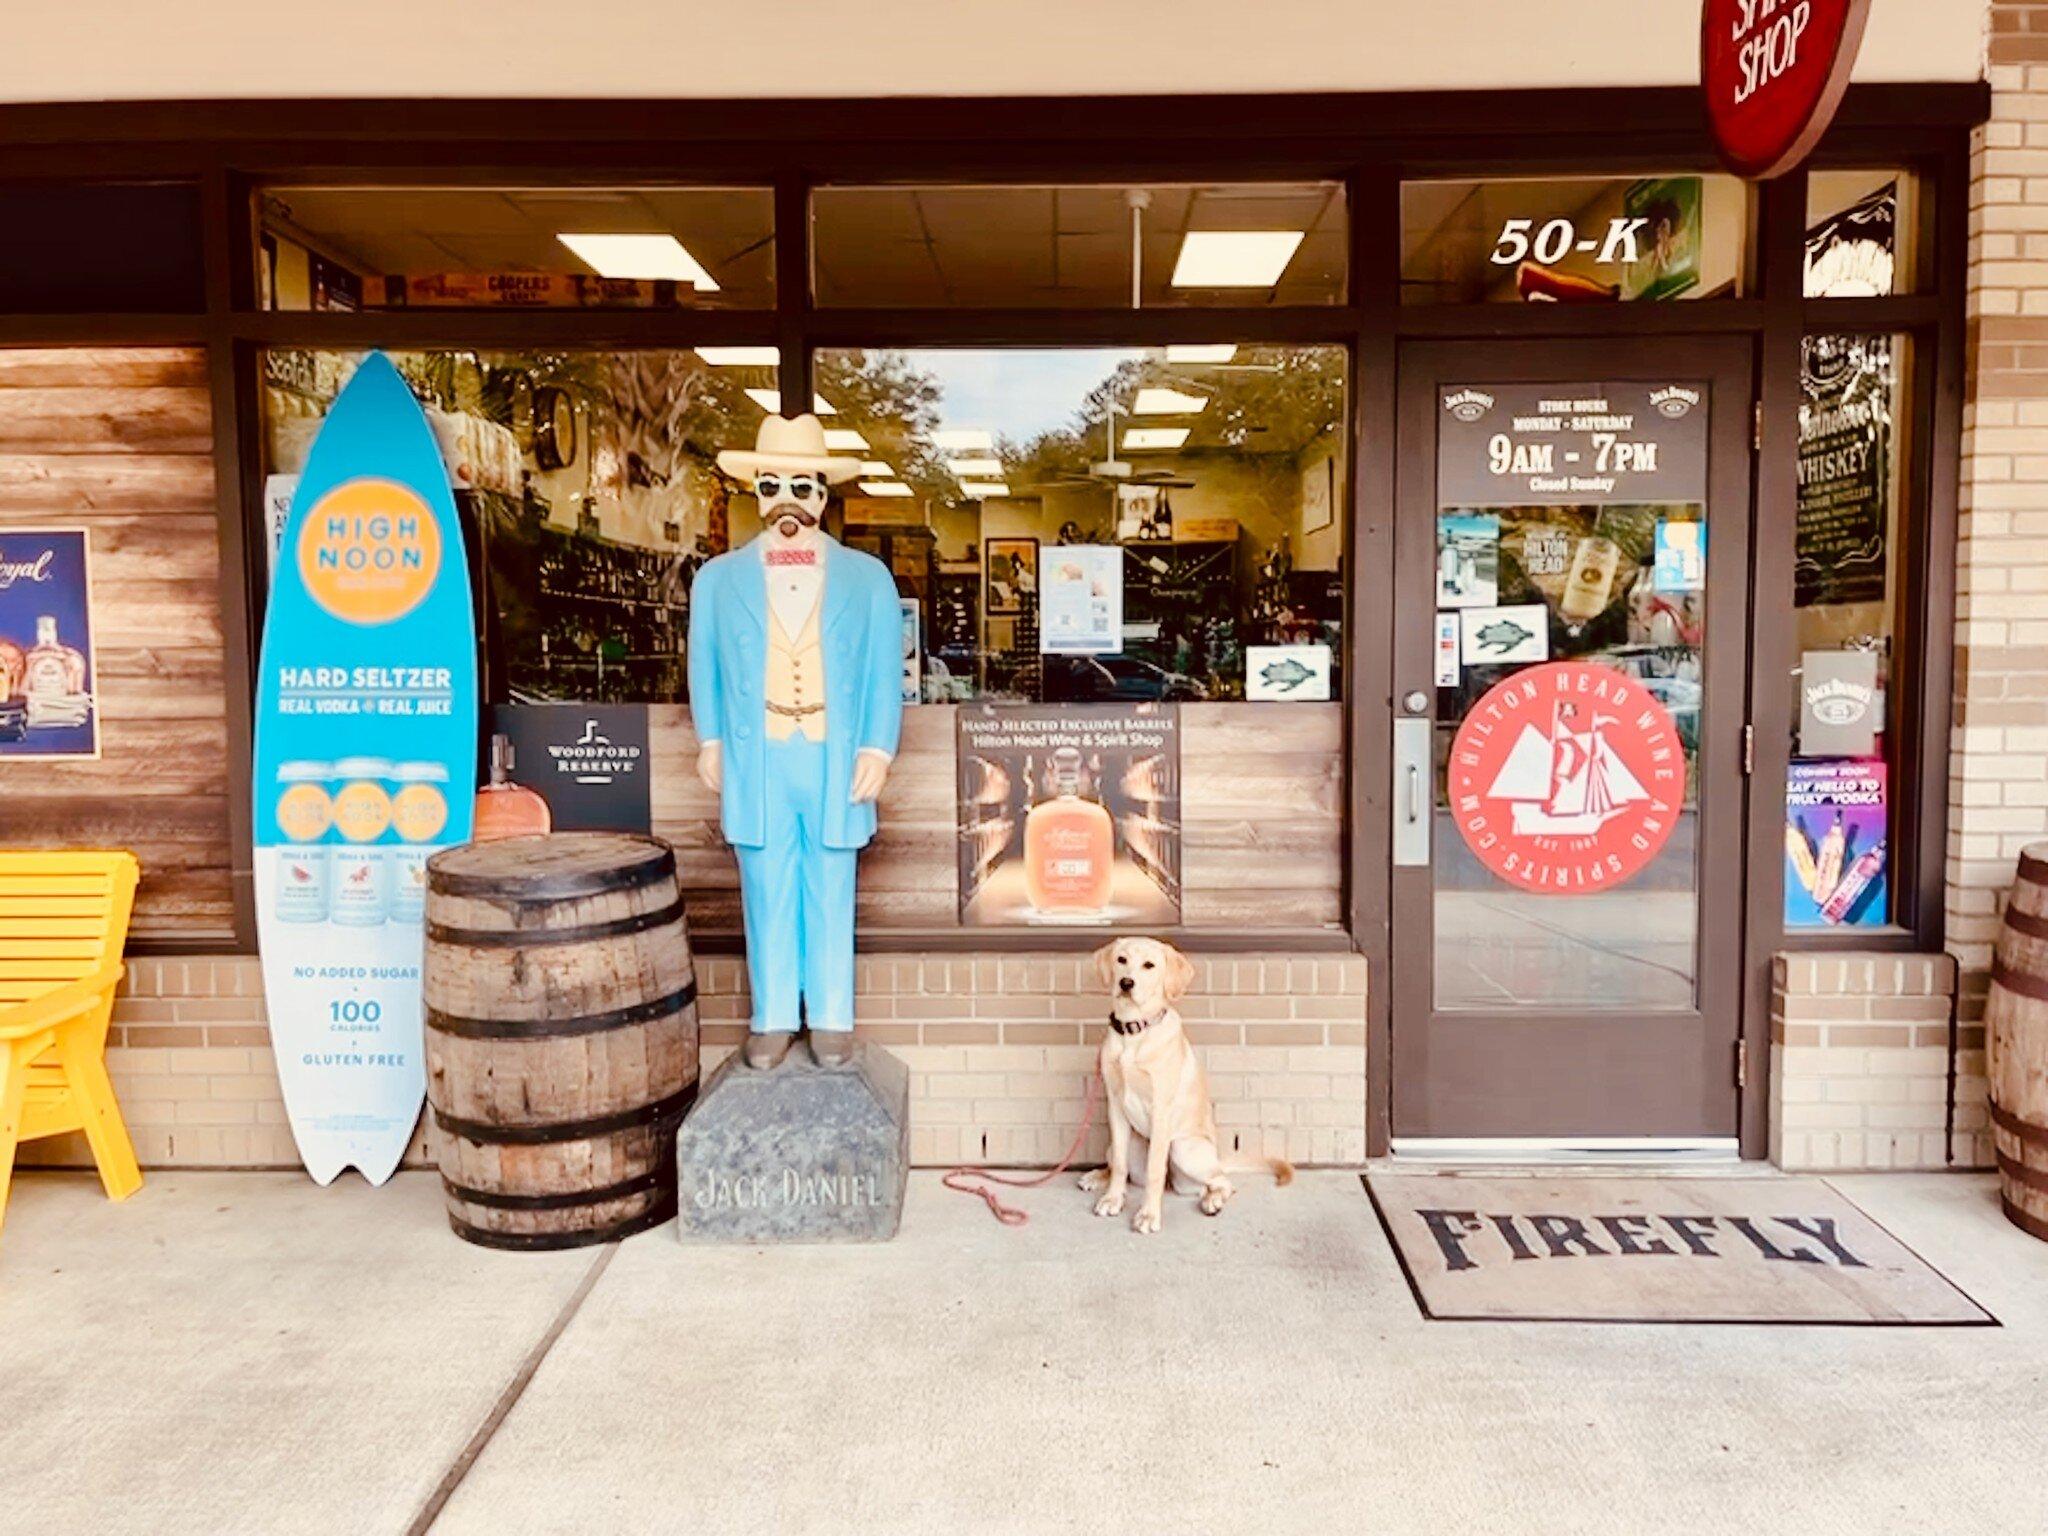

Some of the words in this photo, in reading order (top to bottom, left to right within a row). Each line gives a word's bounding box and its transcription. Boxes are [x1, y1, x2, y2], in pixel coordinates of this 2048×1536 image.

[1734, 1, 1810, 104] SHOP
[1490, 217, 1649, 265] 50-K
[1512, 416, 1562, 431] MONDAY
[1571, 415, 1634, 431] SATURDAY
[1488, 433, 1554, 475] 9AM
[1591, 432, 1657, 472] 7PM
[1529, 477, 1569, 493] Closed
[1570, 476, 1615, 493] Sunday
[328, 517, 416, 540] HIGH
[319, 546, 421, 571] NOON
[280, 667, 348, 688] HARD
[353, 667, 452, 688] SELTZER
[1556, 672, 1629, 706] HEAD
[279, 699, 313, 715] REAL
[315, 699, 360, 715] VODKA
[377, 699, 414, 715] REAL
[1002, 719, 1059, 731] SELECTED
[1459, 679, 1538, 767] HILTON
[548, 745, 641, 758] WOODFORD
[973, 734, 1012, 748] Hilton
[1013, 734, 1047, 747] Head
[1050, 734, 1081, 746] Wine
[1082, 734, 1094, 746] &
[1094, 734, 1129, 748] Spirit
[1130, 734, 1165, 748] Shop
[1637, 709, 1674, 780] WINE
[557, 760, 635, 772] RESERVE
[1630, 797, 1670, 850] AND
[293, 967, 316, 979] NO
[320, 967, 367, 979] ADDED
[371, 967, 419, 979] SUGAR
[329, 1000, 381, 1022] 100
[302, 1053, 362, 1066] GLUTEN
[368, 1053, 406, 1066] FREE
[694, 1168, 768, 1208] JACK
[783, 1167, 883, 1208] DANIEL
[1415, 1208, 1873, 1272] FIREFLY
